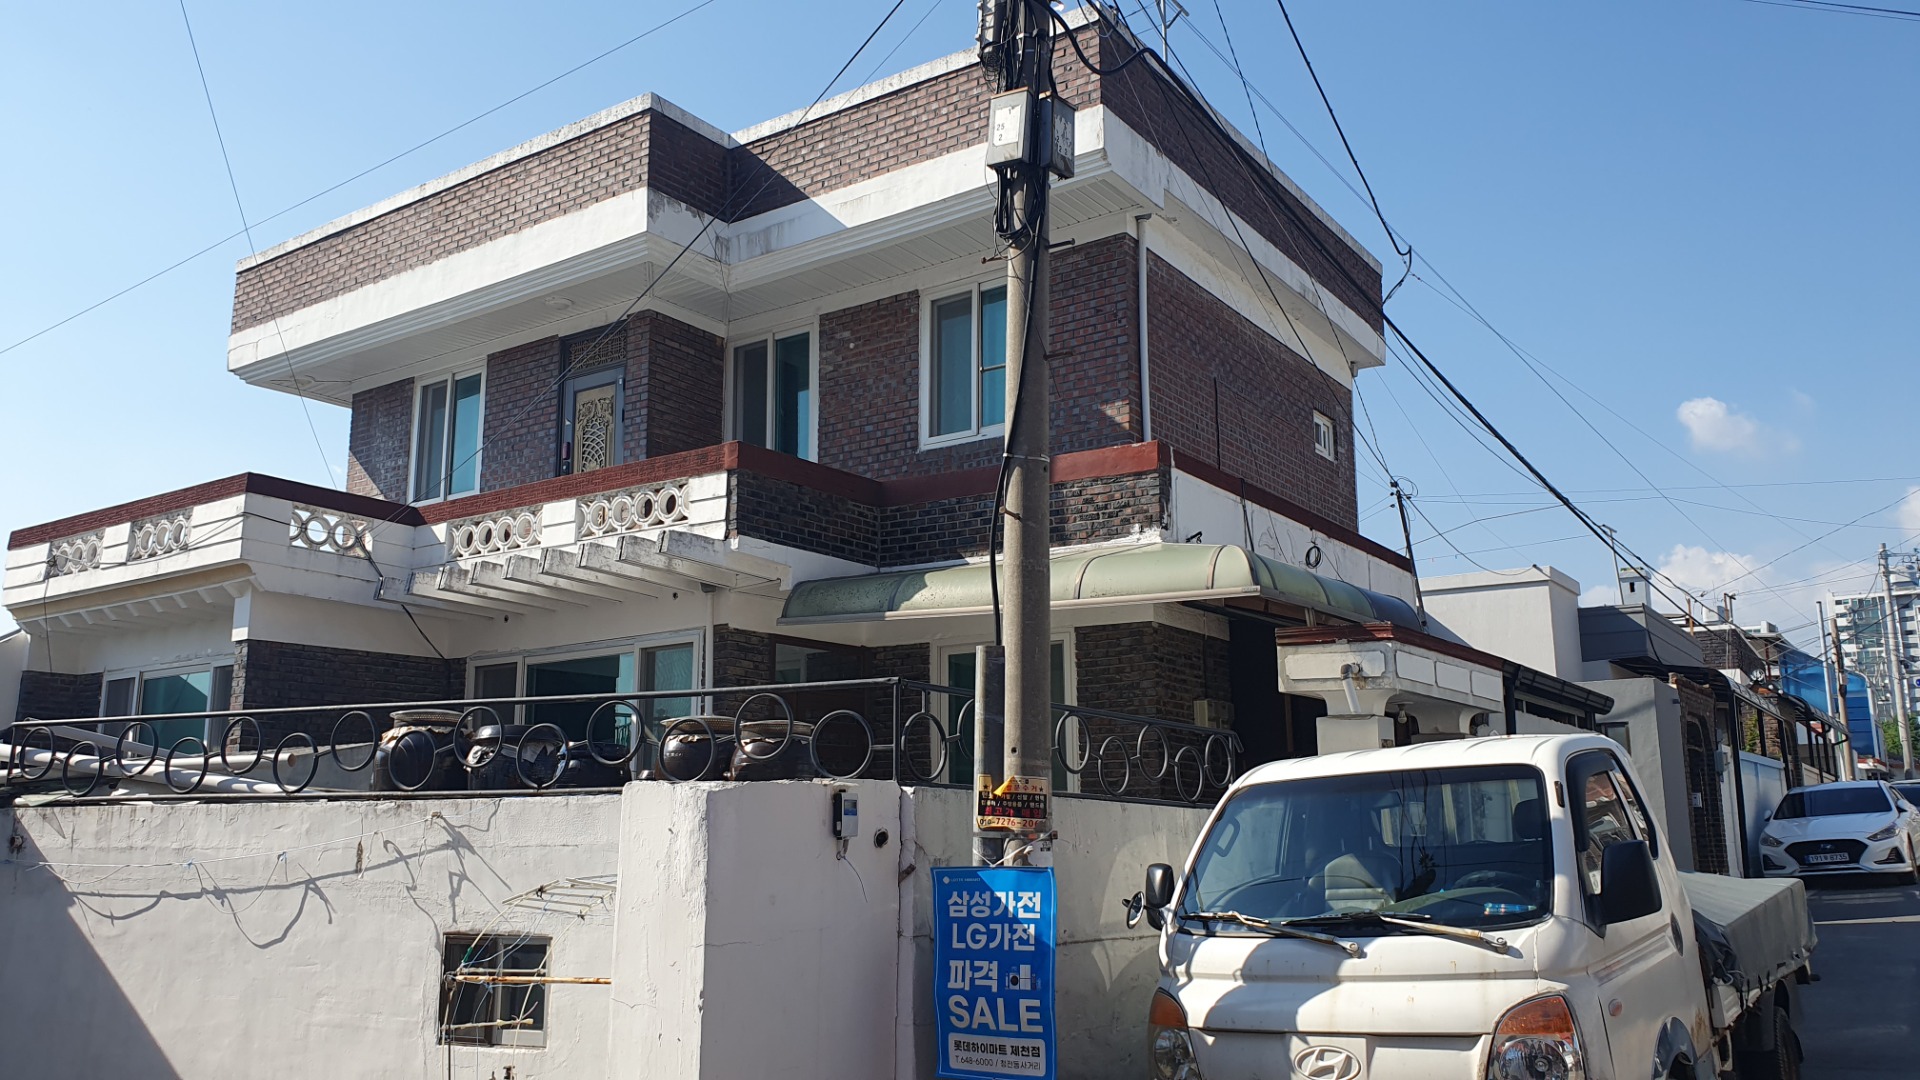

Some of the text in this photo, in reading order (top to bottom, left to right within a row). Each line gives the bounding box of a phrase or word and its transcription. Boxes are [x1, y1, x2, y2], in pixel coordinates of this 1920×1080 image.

[948, 890, 1041, 919] 삼성가전
[952, 922, 1035, 951] LG가전
[947, 959, 998, 993] 파격
[948, 994, 1044, 1033] SALE
[953, 1039, 1041, 1058] 롯데하이마트 제천점
